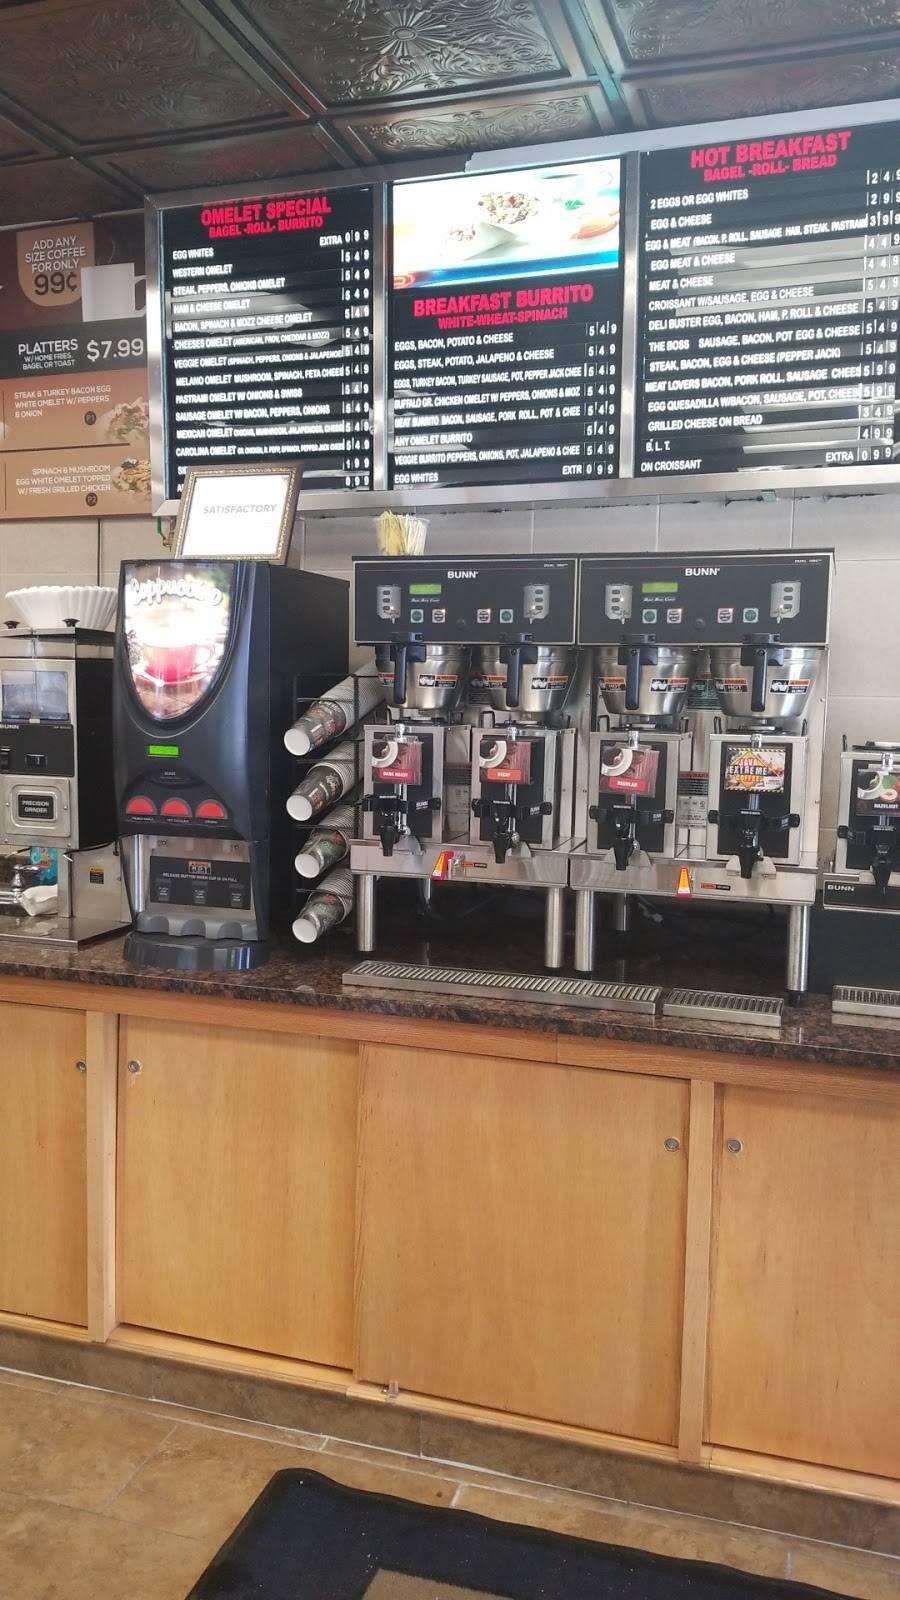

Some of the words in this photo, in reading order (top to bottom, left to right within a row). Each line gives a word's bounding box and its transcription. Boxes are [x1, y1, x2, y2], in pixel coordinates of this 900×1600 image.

[690, 145, 731, 168] HOT
[736, 131, 852, 162] BREAKFAST
[704, 166, 745, 183] BAGEL
[793, 154, 837, 172] BREAD
[651, 199, 656, 209] 2
[657, 197, 680, 208] EGGS
[682, 195, 695, 205] OR
[696, 192, 715, 204] EGG
[716, 189, 748, 202] WHITES
[201, 204, 261, 226] OMELET
[266, 197, 331, 218] SPECIAL
[209, 226, 242, 239] BAGEL
[278, 216, 323, 231] BURRITO
[651, 218, 669, 230] EGG
[678, 214, 712, 227] CHEESE
[33, 240, 53, 250] ADD
[55, 236, 76, 248] ANY
[319, 234, 342, 246] EXTRA
[645, 240, 662, 251] EGG
[25, 252, 45, 263] SIZE
[47, 247, 86, 259] COFFEE
[173, 250, 187, 260] EGG
[188, 248, 214, 259] WHITES
[32, 262, 52, 273] FOR
[54, 259, 80, 270] ONLY
[651, 259, 670, 271] EGG
[671, 257, 692, 269] MEAT
[701, 253, 735, 266] CHEESE
[173, 266, 204, 278] WESTERN
[205, 264, 233, 276] OMELET
[258, 278, 285, 289] OMELET
[649, 278, 671, 291] MEAT
[680, 276, 714, 289] CHEESE
[414, 292, 512, 316] BREAKFAST
[516, 284, 594, 307] BURRITO
[649, 297, 696, 311] CROISSANT
[751, 288, 770, 302] EGG
[778, 284, 814, 299] CHEESE
[196, 301, 221, 313] CHEESE
[223, 300, 250, 310] OMELET
[200, 320, 229, 330] SPINACH
[257, 315, 283, 327] CHEESE
[285, 312, 312, 323] OMELET
[649, 320, 668, 331] DELI
[669, 317, 701, 330] BUSTER
[790, 306, 813, 319] ROLL
[823, 303, 859, 316] CHEESE
[207, 336, 232, 347] OMELET
[447, 336, 474, 347] POTATO
[483, 332, 514, 344] CHEESE
[649, 341, 665, 352] THE
[667, 339, 689, 351] BOSS
[776, 331, 793, 343] POT
[796, 330, 815, 341] EGG
[825, 325, 860, 339] CHEESE
[18, 339, 78, 355] PLATTERS
[86, 338, 144, 362] $7.99
[174, 357, 199, 369] VEGGIE
[200, 356, 227, 367] OMELET
[476, 352, 515, 364] JALAPENO
[524, 349, 554, 361] CHEESE
[713, 355, 732, 367] EGG
[741, 352, 775, 365] CHEESE
[23, 362, 43, 370] BAGEL
[205, 374, 232, 385] OMELET
[305, 367, 321, 378] FETA
[412, 378, 435, 388] TURKEY
[458, 374, 480, 385] TURKEY
[645, 381, 667, 393] MEAT
[668, 377, 700, 390] LOVERS
[734, 376, 758, 388] PORK
[787, 369, 828, 382] SAUSAGE
[14, 391, 36, 399] STEAK
[71, 386, 96, 395] BACON
[176, 393, 209, 404] PASTRAMI
[209, 391, 236, 403] OMELET
[281, 387, 302, 398] SWISS
[15, 401, 36, 409] WHITE
[38, 399, 65, 407] OMELET
[78, 395, 110, 403] PEPPERS
[394, 399, 421, 410] BUFFALO
[435, 394, 463, 406] CHICKEN
[464, 393, 489, 404] OMELET
[648, 401, 667, 412] EGG
[668, 397, 719, 412] QUESADILLA
[176, 409, 206, 422] SAUSAGE
[207, 409, 234, 421] OMELET
[303, 404, 330, 415] ONIONS
[413, 416, 439, 427] BURRITO
[499, 410, 516, 422] PORK
[648, 417, 683, 431] GRILLED
[685, 415, 717, 429] CHEESE
[719, 416, 731, 427] ON
[733, 413, 763, 426] BREAD
[176, 428, 206, 439] MEXICAN
[207, 426, 233, 437] OMELET
[394, 436, 409, 446] ANY
[410, 435, 439, 445] OMELET
[440, 433, 472, 444] BURRITO
[176, 444, 209, 457] CAROLINA
[210, 443, 236, 456] OMELET
[395, 454, 418, 466] VEGGIE
[419, 453, 445, 464] BURRITO
[521, 447, 555, 459] JALAPENO
[825, 449, 854, 462] EXTRA
[32, 468, 61, 476] SPINACH
[69, 465, 110, 473] MUSHROOM
[641, 462, 653, 473] ON
[654, 458, 702, 471] CROISSANT
[16, 478, 30, 486] EGG
[31, 477, 52, 485] WHITE
[54, 475, 80, 483] OMELET
[82, 474, 110, 482] TOPPED
[394, 473, 410, 483] EGG
[411, 471, 438, 483] WHITES
[29, 486, 51, 494] FRESH
[52, 484, 79, 493] GRILLED
[81, 482, 110, 491] CHICKEN
[203, 504, 277, 514] SATISFACTORY
[447, 570, 475, 579] BUNN
[685, 568, 717, 576] BUNN
[729, 766, 768, 775] EXTREME
[24, 806, 48, 814] GRINDER
[827, 884, 855, 892] BUNN
